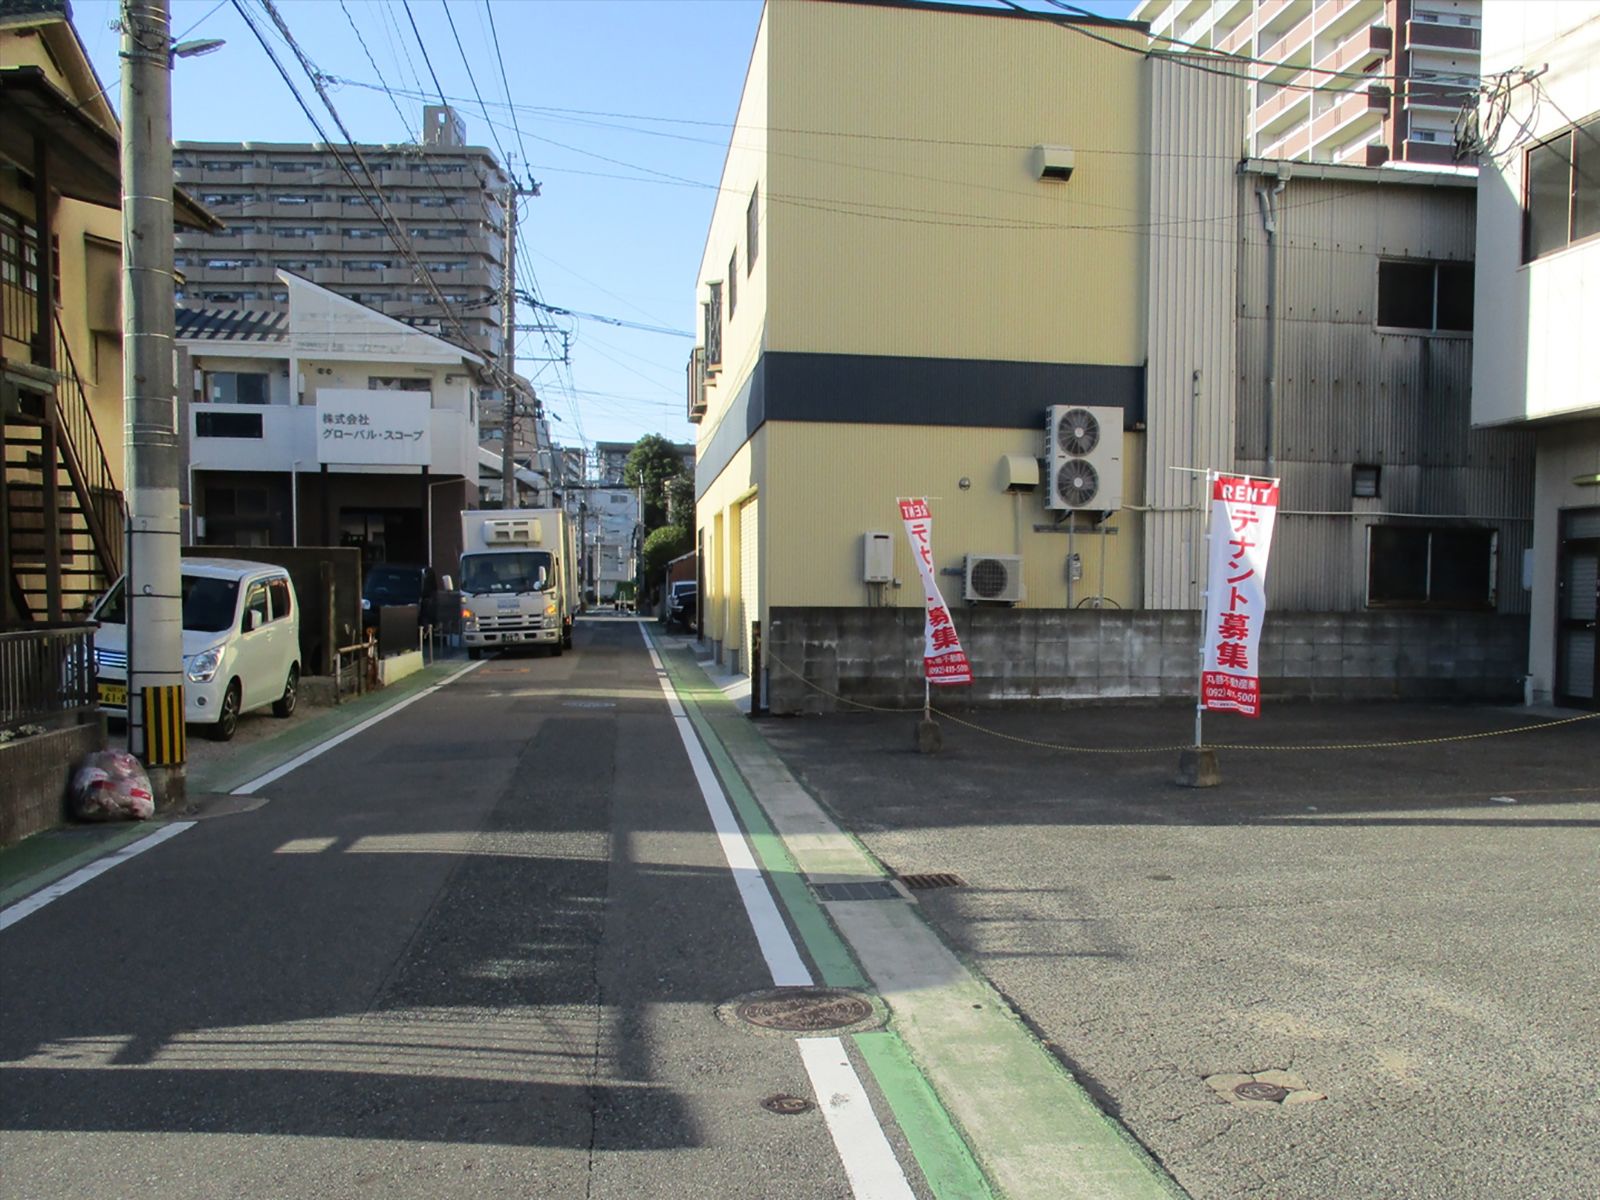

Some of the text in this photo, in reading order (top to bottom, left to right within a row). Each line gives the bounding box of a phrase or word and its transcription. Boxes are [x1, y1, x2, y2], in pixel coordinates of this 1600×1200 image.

[322, 413, 370, 426] 株式会社
[1222, 484, 1271, 504] RENT
[913, 524, 958, 650] テナ募集
[1216, 509, 1259, 669] テナント募集
[105, 692, 126, 703] 61-8
